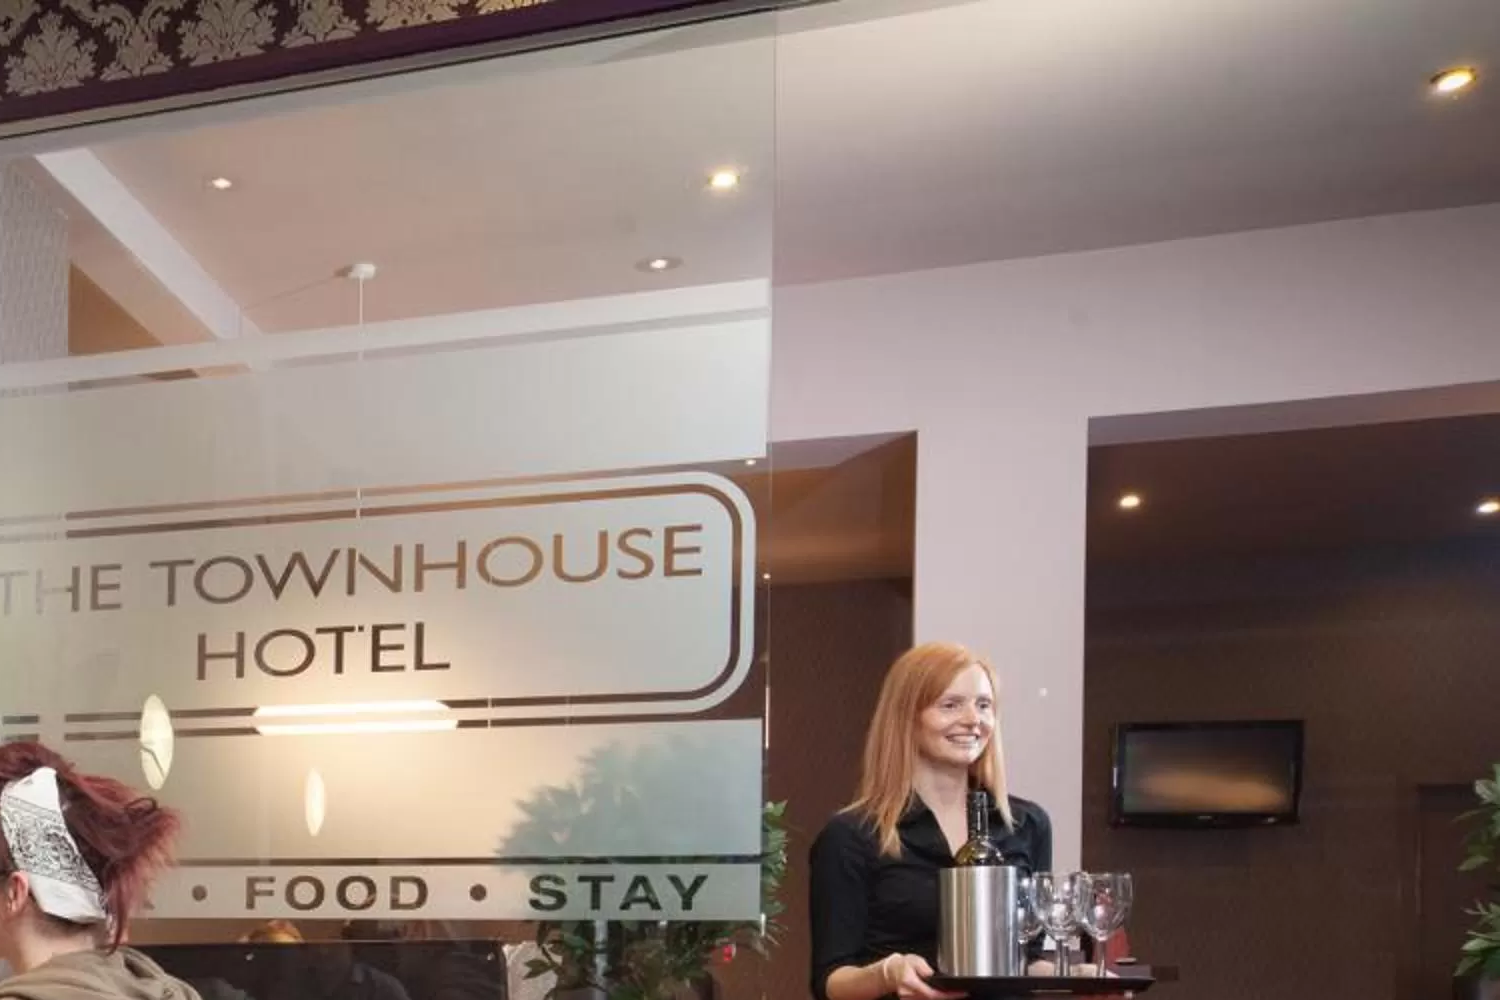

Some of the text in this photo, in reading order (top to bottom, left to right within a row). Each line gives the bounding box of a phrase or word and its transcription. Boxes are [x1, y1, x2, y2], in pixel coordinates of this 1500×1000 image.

[149, 524, 702, 608] TOWNHOUSE
[196, 621, 450, 680] HOTEL
[245, 874, 708, 911] FOOD STAY
